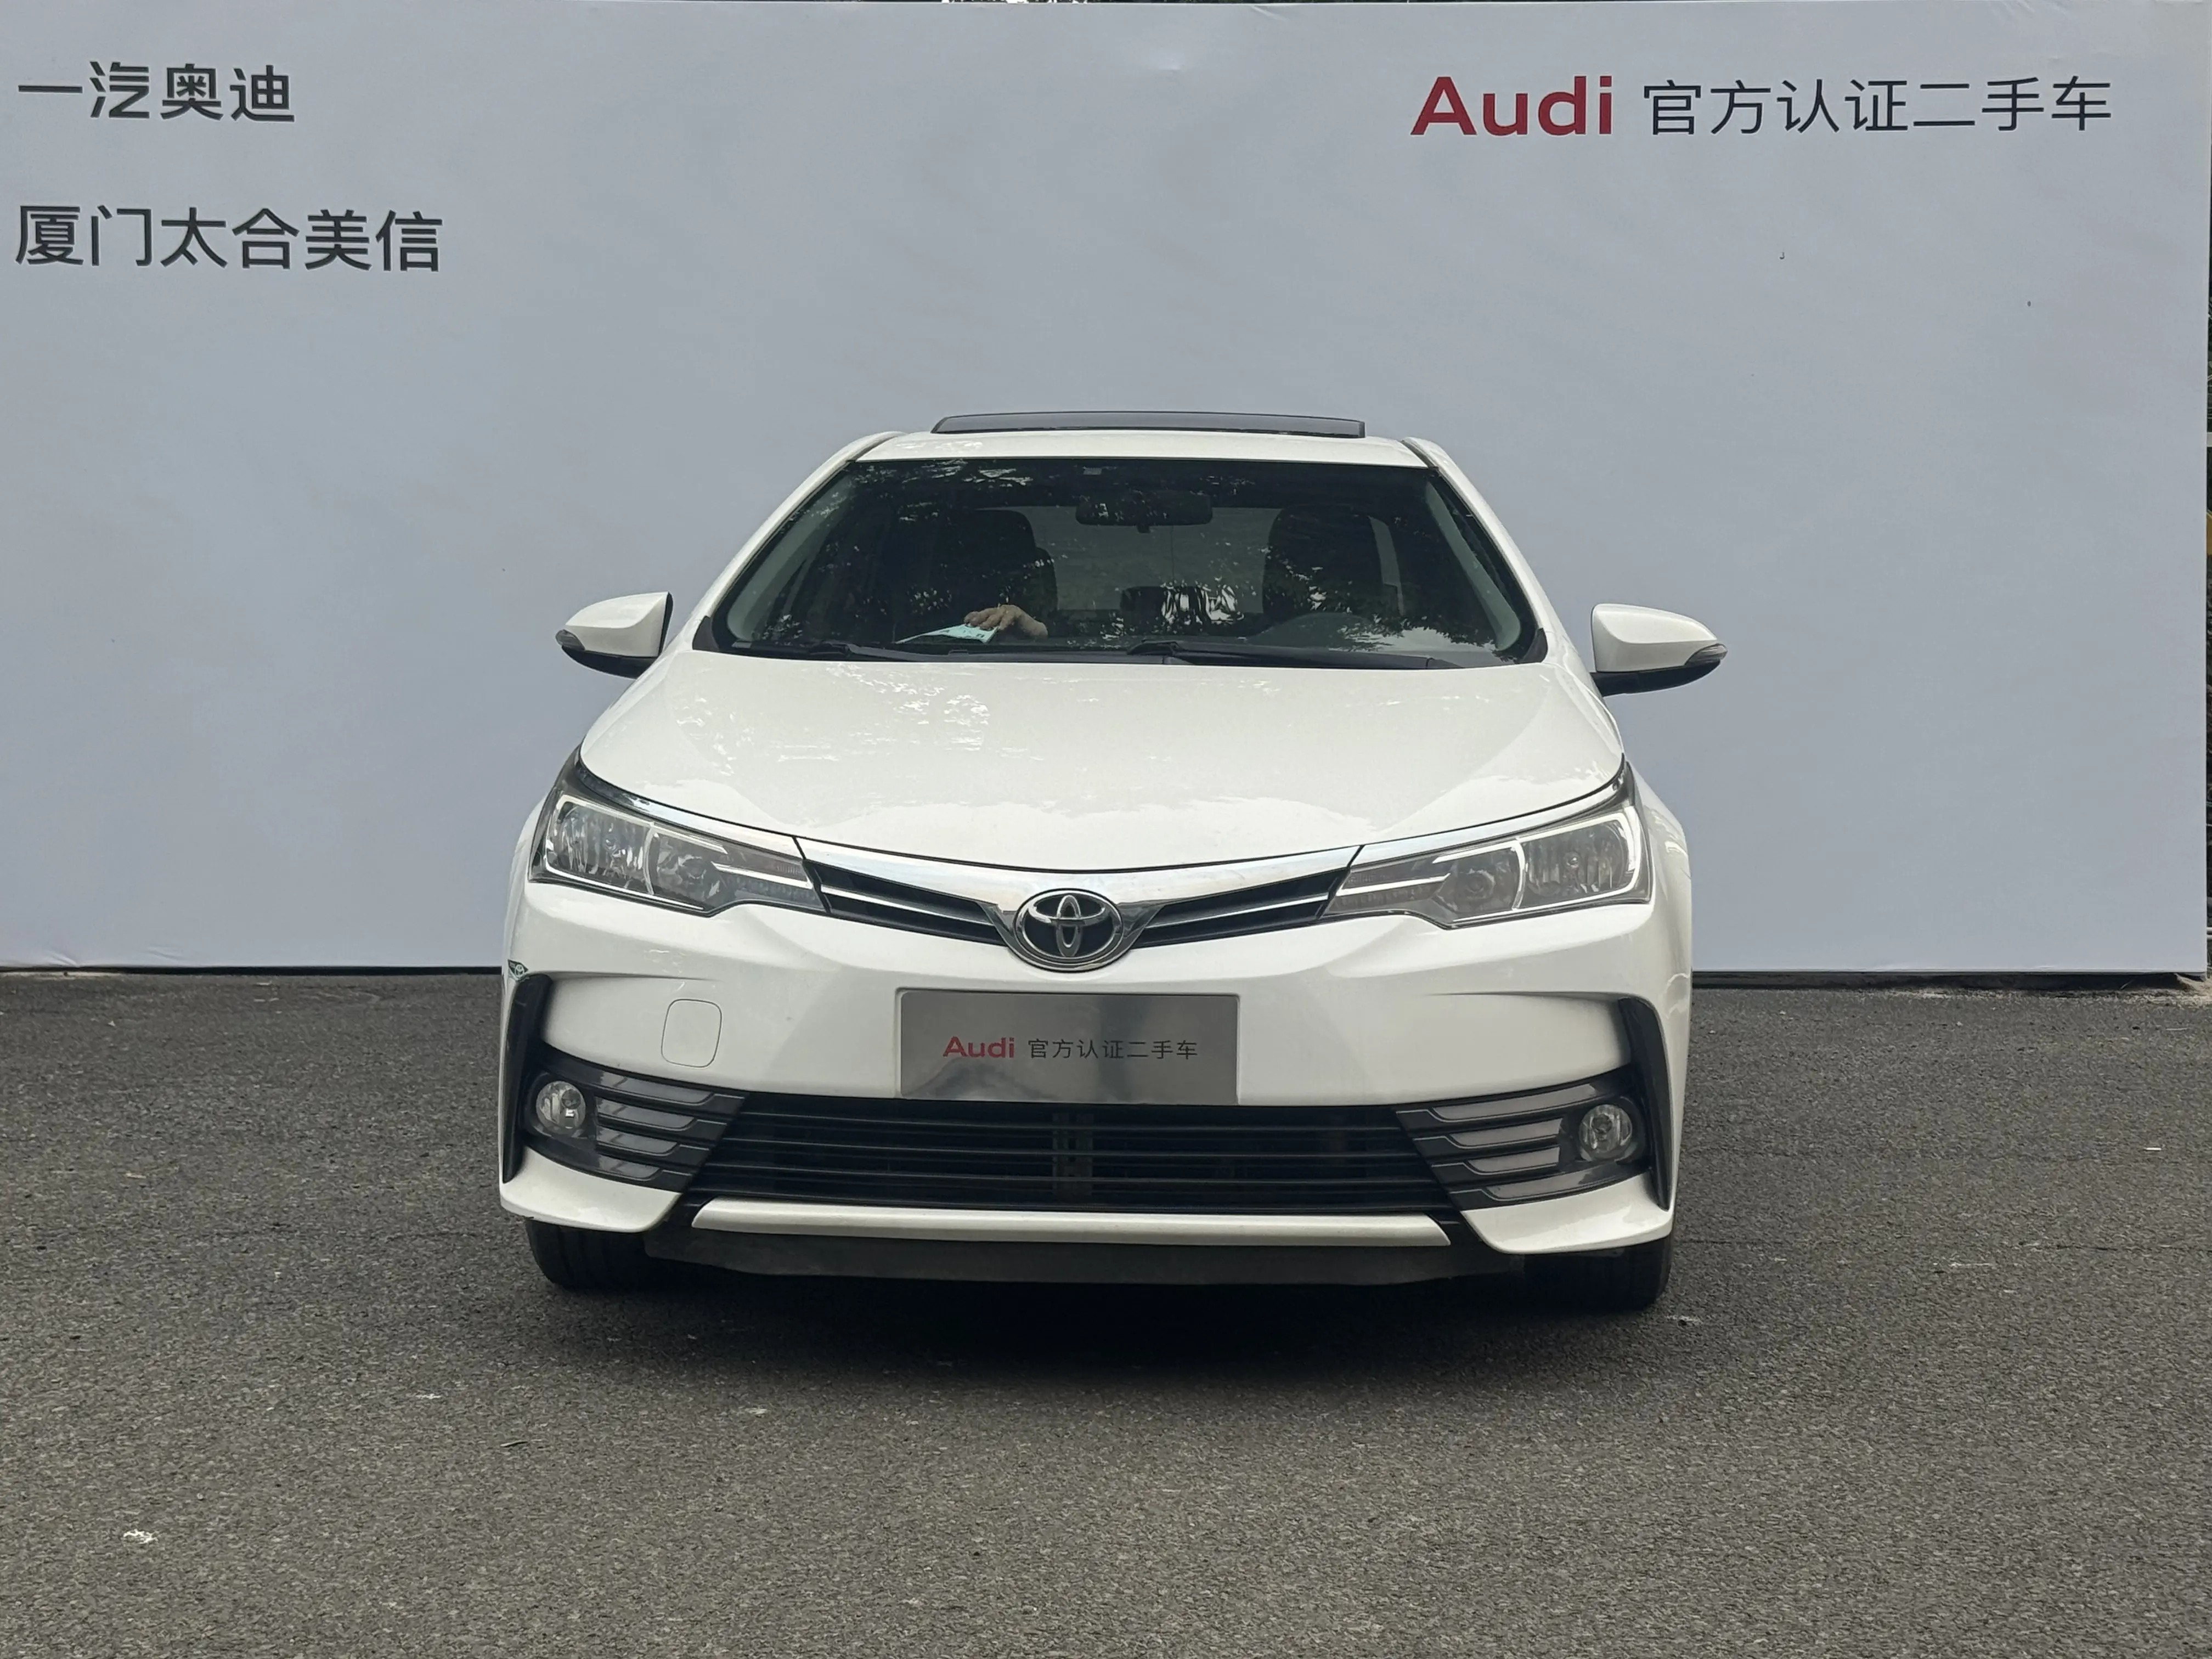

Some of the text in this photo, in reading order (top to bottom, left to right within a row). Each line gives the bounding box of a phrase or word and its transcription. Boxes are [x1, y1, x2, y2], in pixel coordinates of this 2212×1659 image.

[18, 61, 295, 122] 一汽奥迪
[1412, 76, 2112, 136] Audi 官方认证二手车
[16, 205, 442, 271] 厦门太合美信
[943, 1035, 1198, 1059] Audi 官方认证二手车
